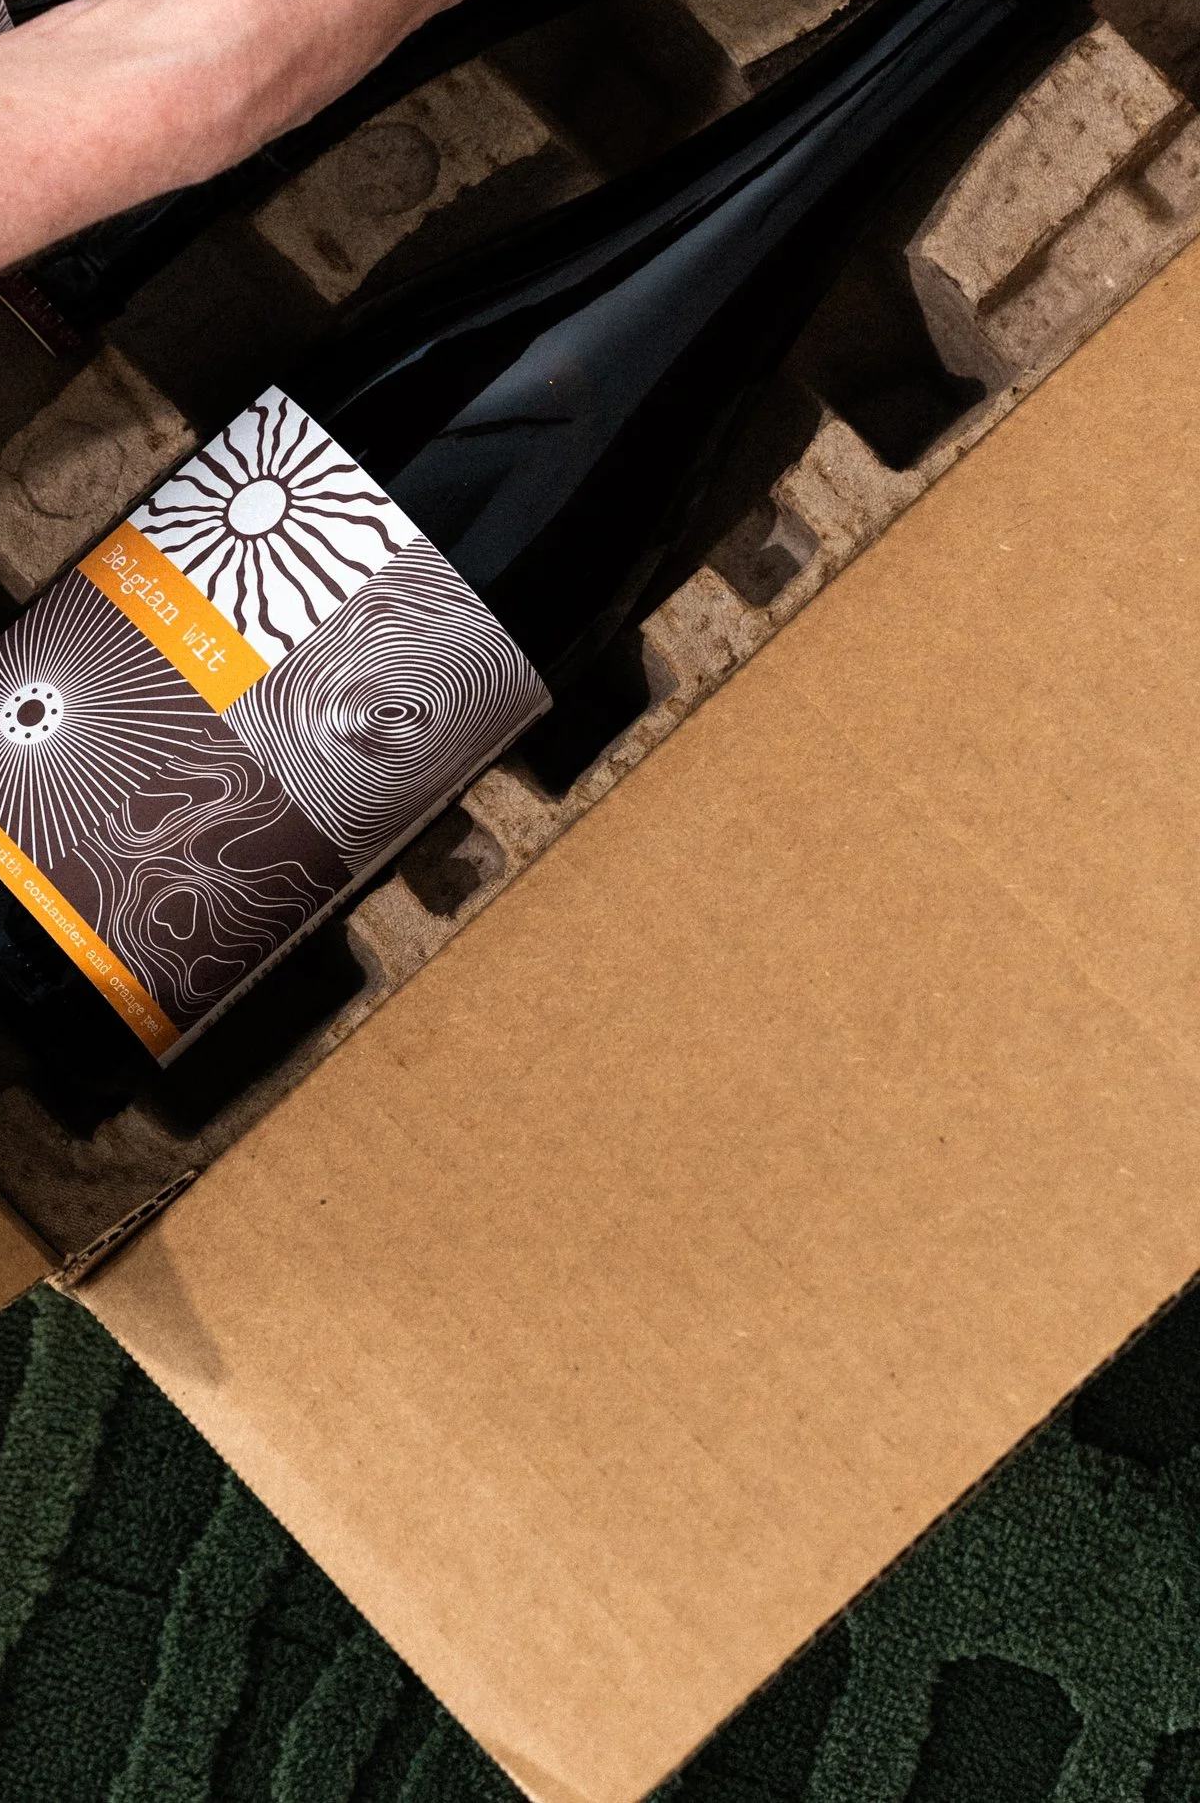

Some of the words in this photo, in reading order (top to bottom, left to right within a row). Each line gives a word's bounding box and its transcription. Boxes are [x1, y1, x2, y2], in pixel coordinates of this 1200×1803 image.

[102, 544, 180, 626] Belgian
[182, 623, 227, 672] Wit
[24, 879, 87, 947] coriander
[86, 949, 112, 975] and
[109, 976, 145, 1014] orange
[141, 1016, 163, 1037] peel
